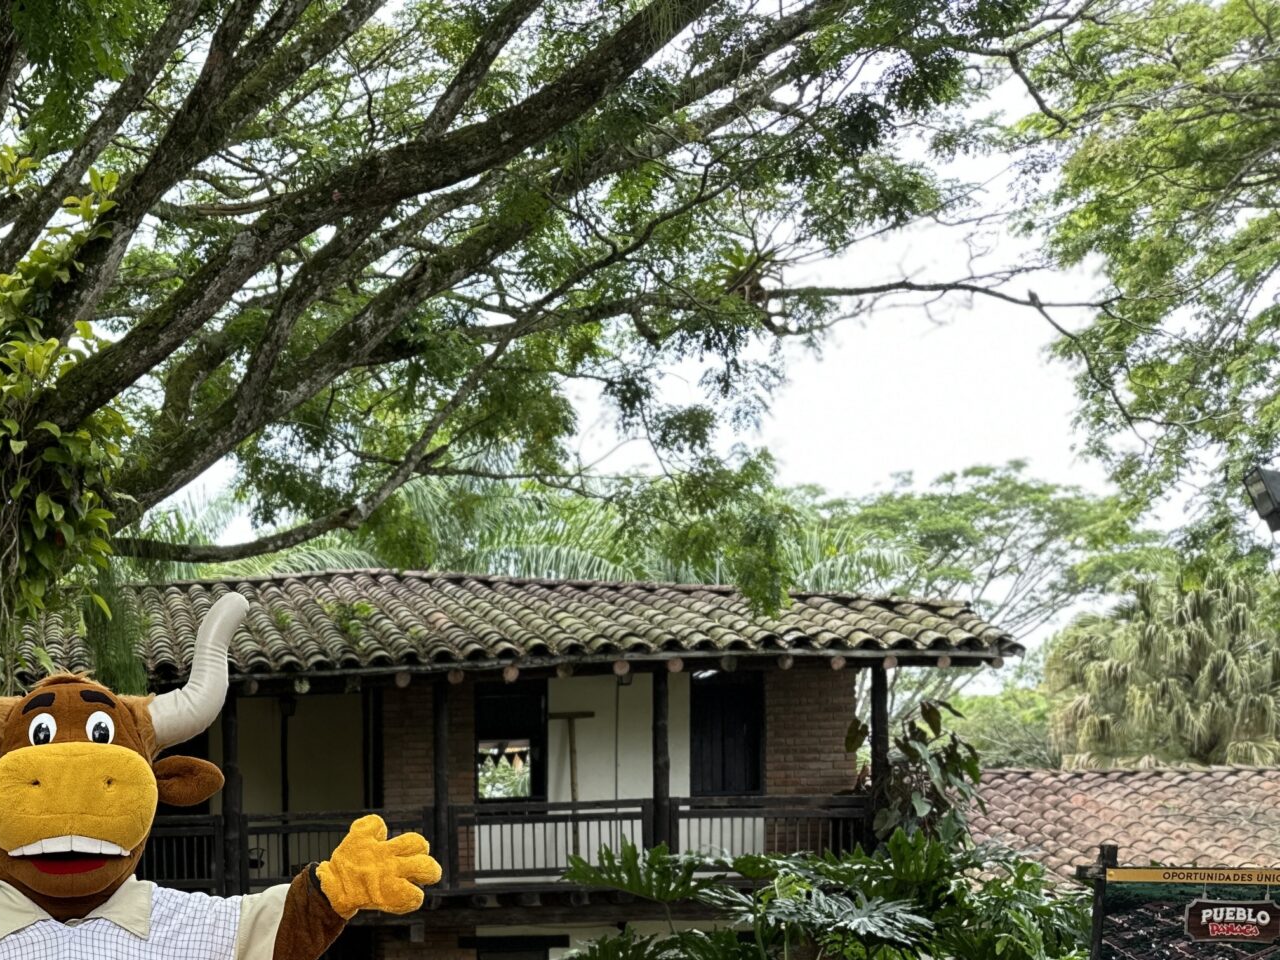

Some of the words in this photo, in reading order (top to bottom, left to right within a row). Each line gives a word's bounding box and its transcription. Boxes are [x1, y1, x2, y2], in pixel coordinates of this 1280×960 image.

[1163, 872, 1253, 881] OPORTUNIDADES
[1201, 907, 1270, 926] PUEBLO
[1209, 923, 1259, 936] PANACA
